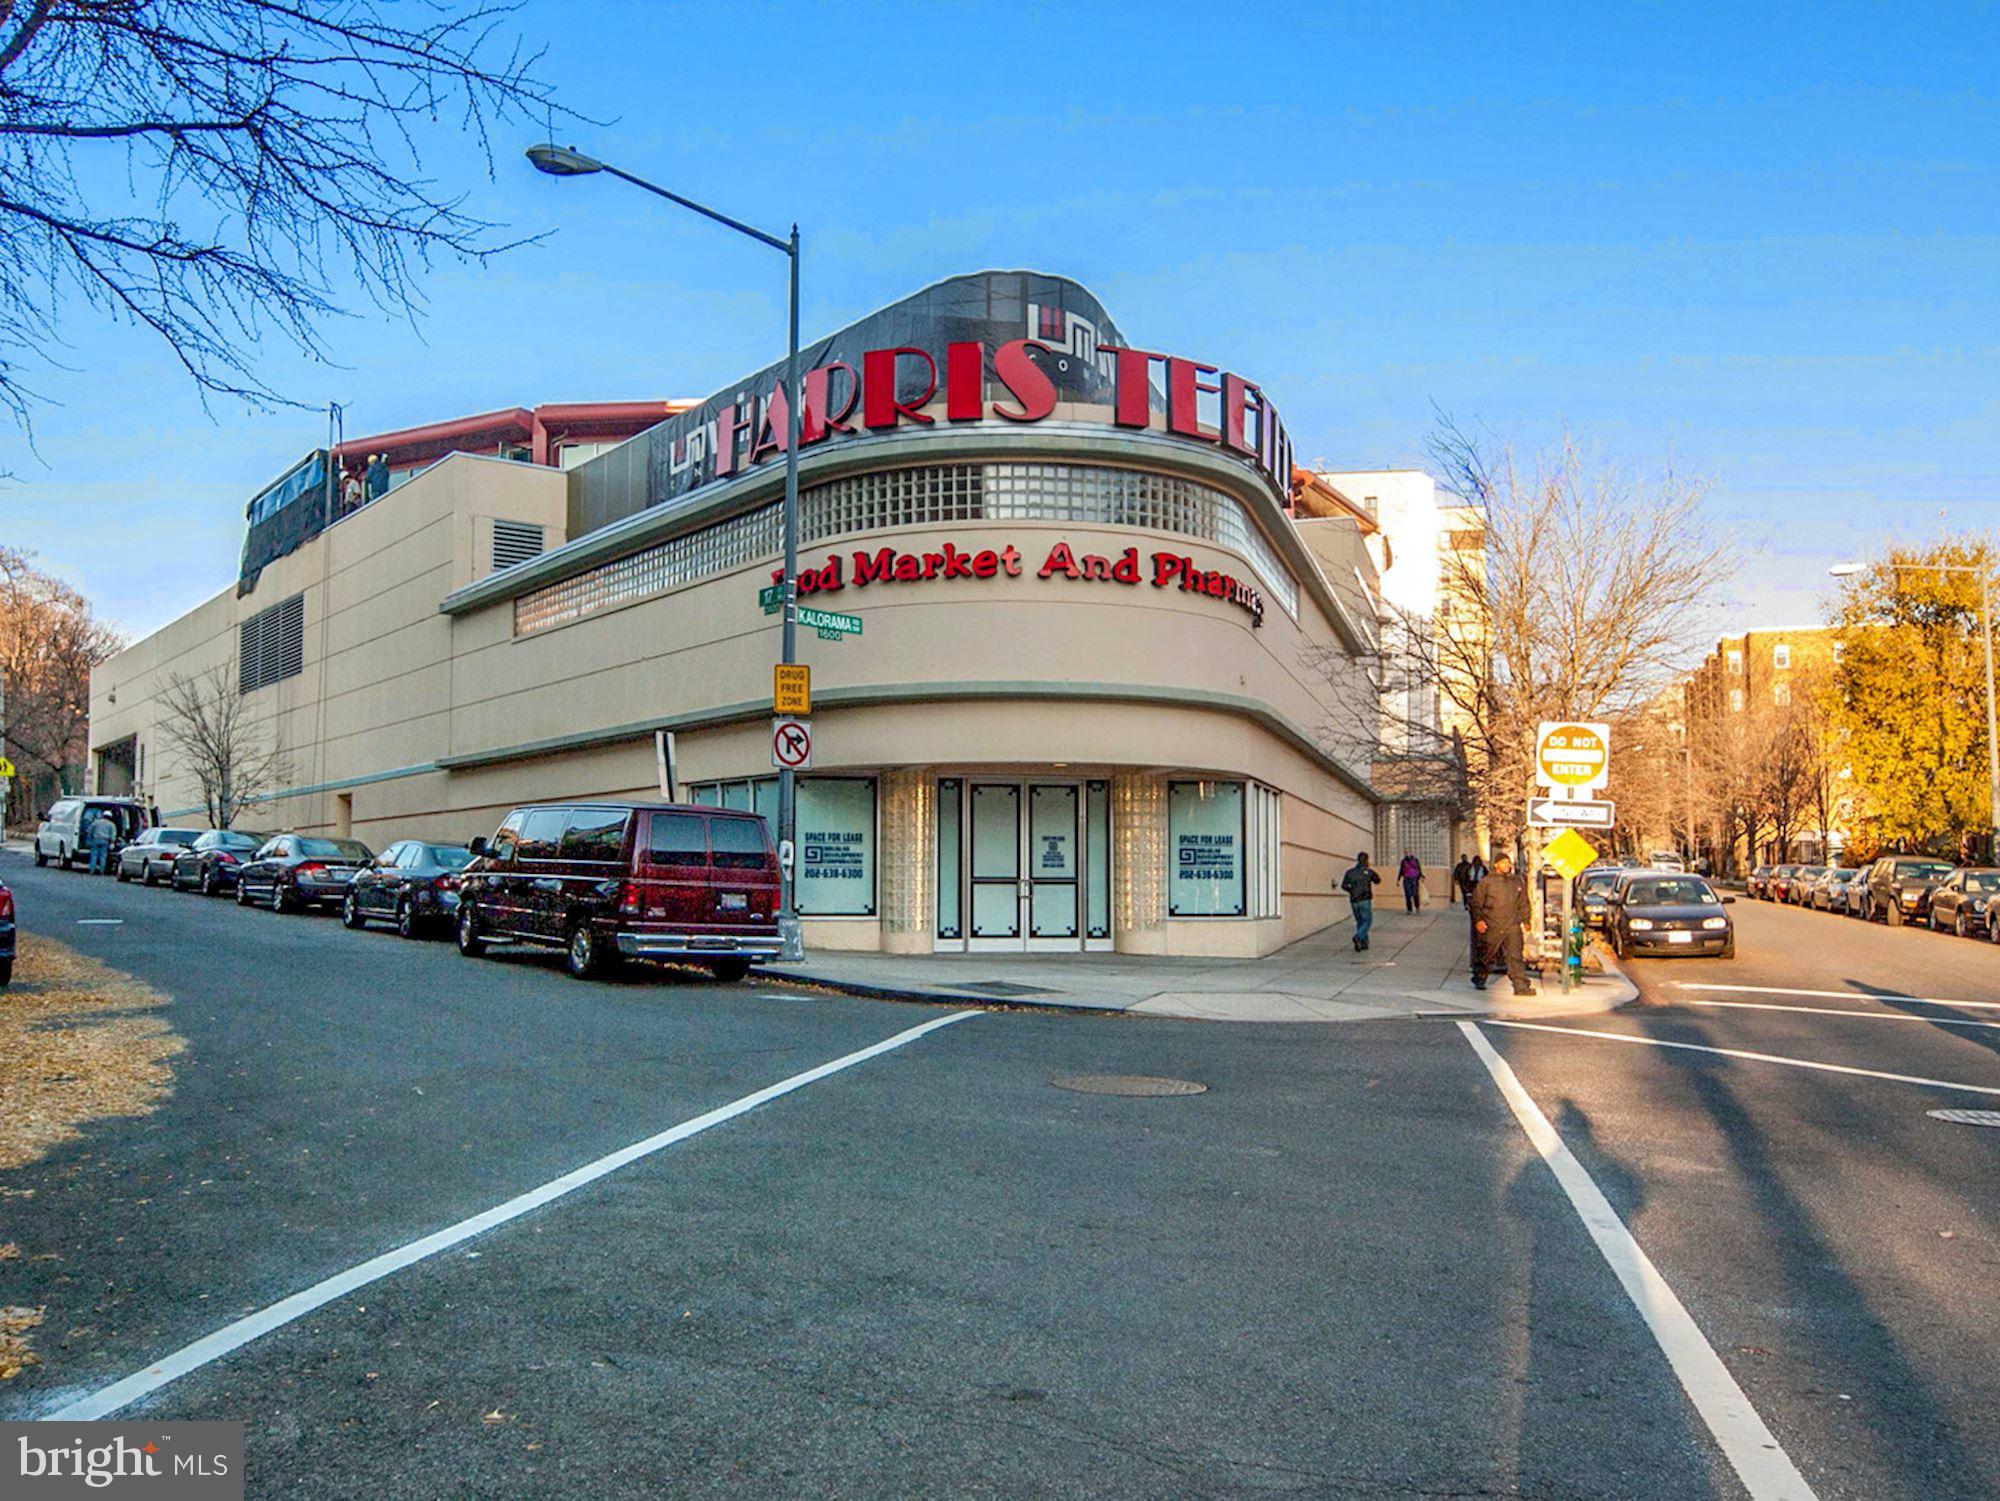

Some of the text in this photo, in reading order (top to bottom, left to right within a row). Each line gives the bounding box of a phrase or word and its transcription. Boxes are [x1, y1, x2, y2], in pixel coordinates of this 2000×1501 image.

[715, 338, 1058, 477] HARRIS
[852, 542, 1023, 587] Market
[1037, 541, 1143, 584] And
[798, 609, 852, 632] KALORAMA
[819, 629, 841, 640] 1600
[780, 670, 805, 680] DRUG
[781, 683, 804, 693] FREE
[782, 696, 803, 706] ZONE
[1548, 735, 1598, 748] DO NOT
[1552, 763, 1592, 777] ENTER
[804, 832, 863, 843] SPACE FOR LEASE
[1179, 835, 1233, 845] SPACE FOR LEASE
